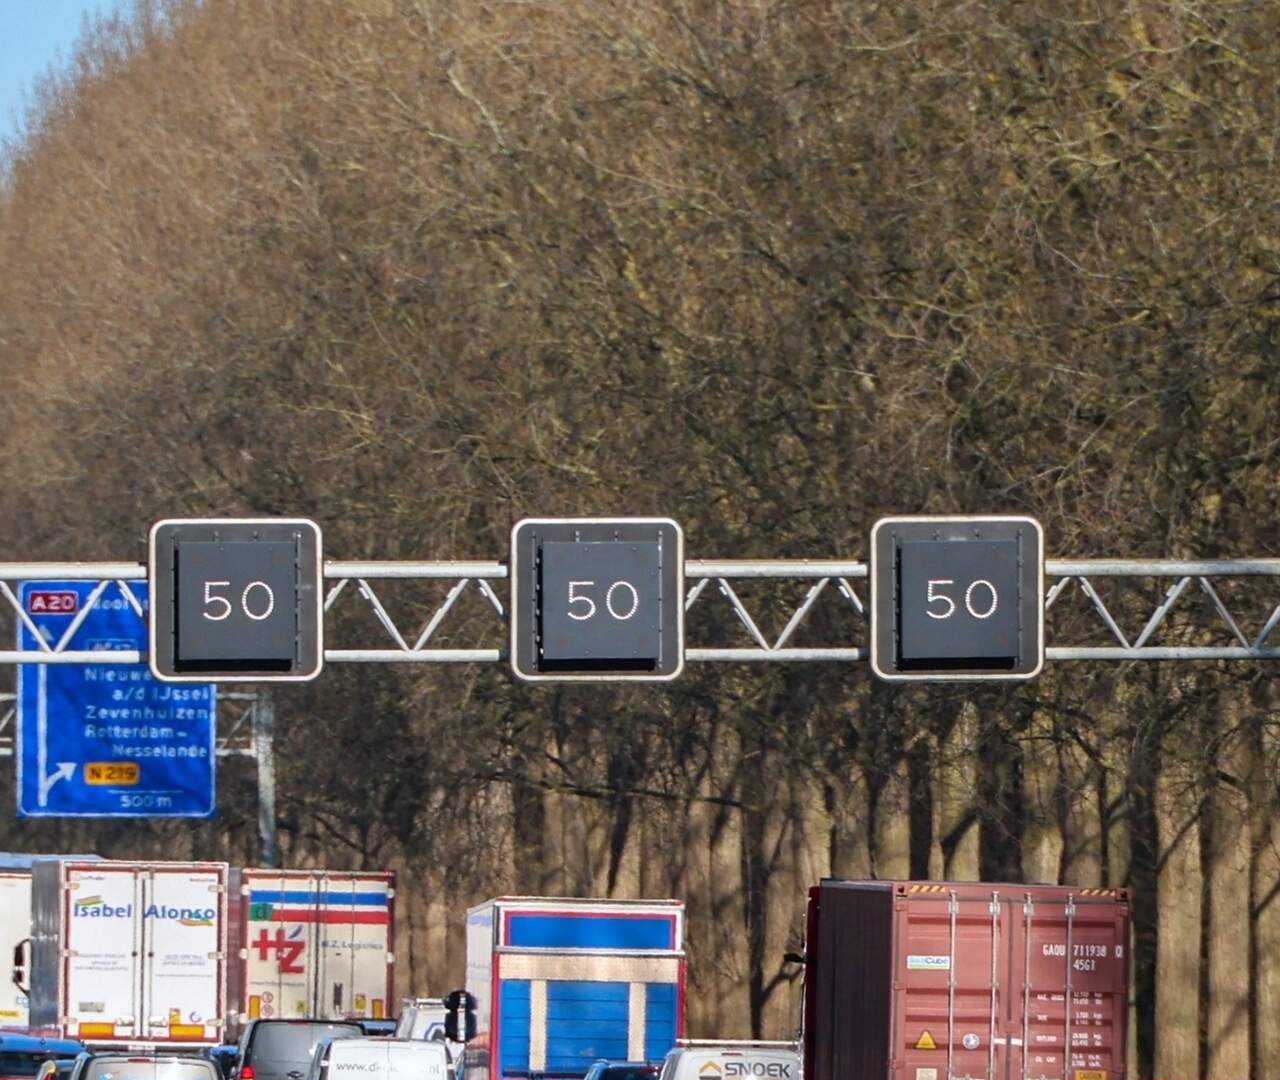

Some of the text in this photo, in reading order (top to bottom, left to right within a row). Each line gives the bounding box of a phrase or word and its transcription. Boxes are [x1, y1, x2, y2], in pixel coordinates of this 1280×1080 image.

[31, 595, 75, 610] A20
[203, 581, 275, 621] 50
[566, 581, 639, 621] 50
[925, 579, 999, 621] 50
[84, 705, 209, 719] Zevenhuizen
[112, 745, 208, 758] Nesselande
[121, 796, 172, 808] 500 m
[73, 903, 216, 919] Isabel Alonso
[724, 1062, 791, 1078] SNOEK
